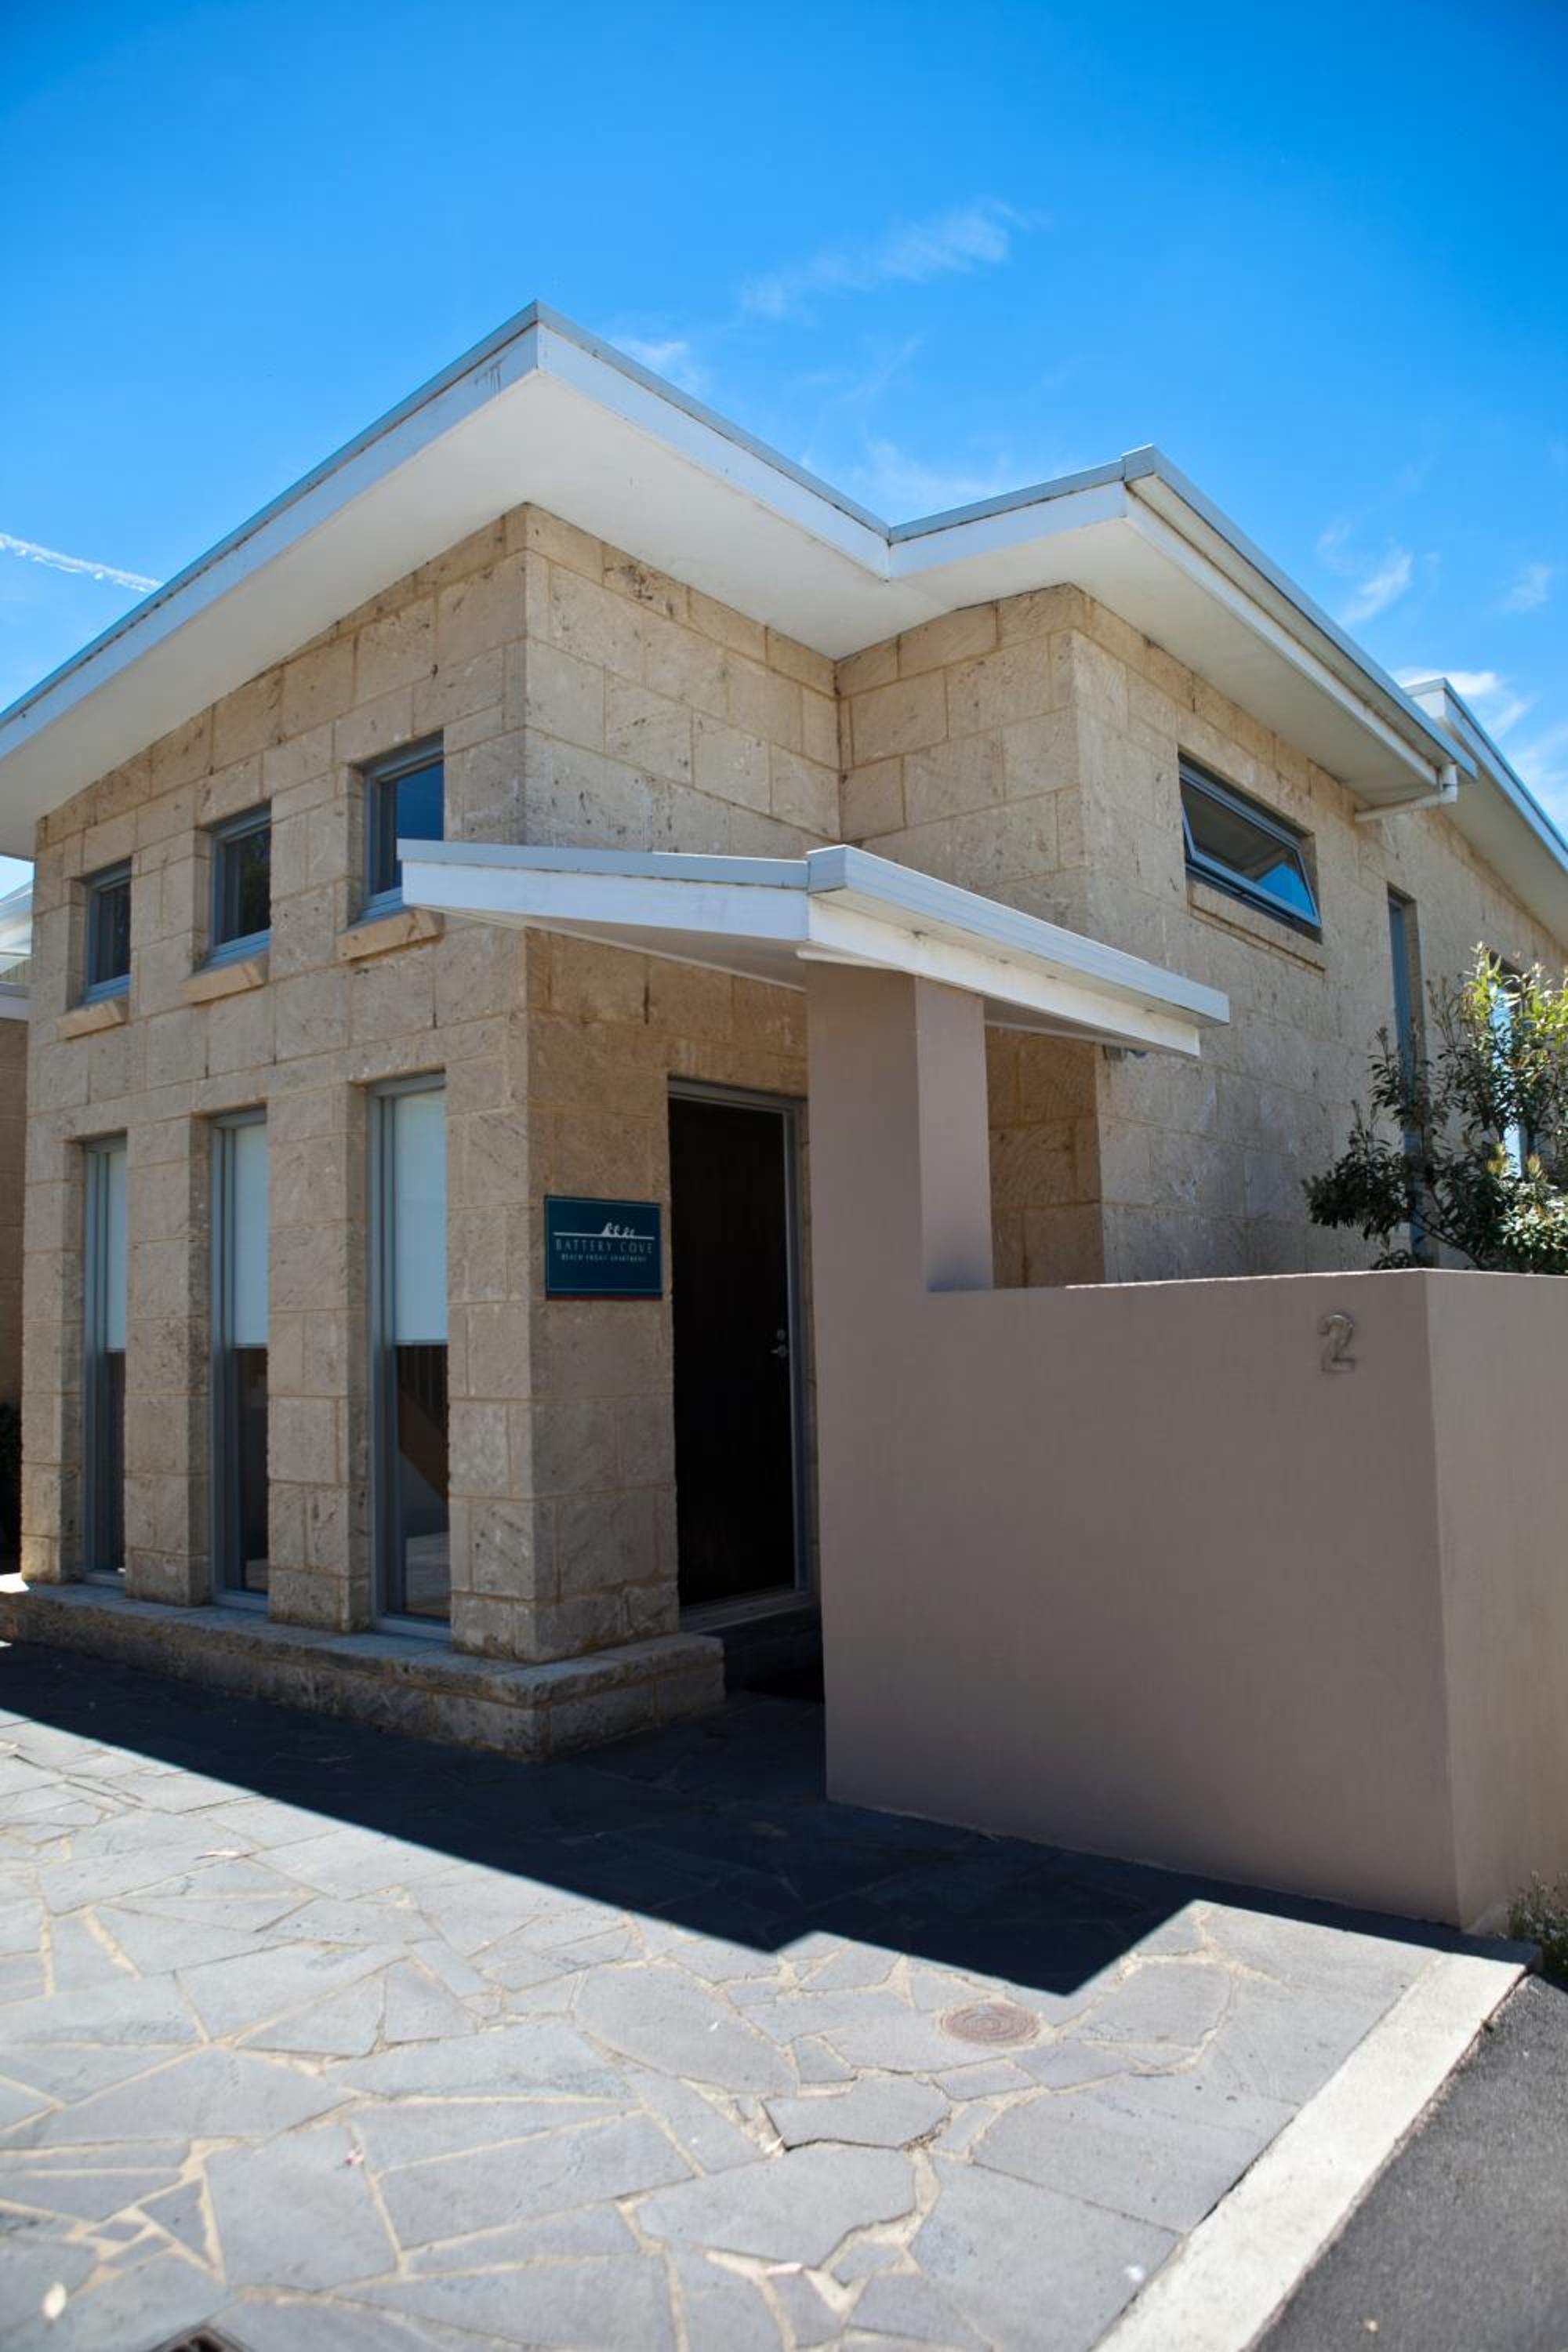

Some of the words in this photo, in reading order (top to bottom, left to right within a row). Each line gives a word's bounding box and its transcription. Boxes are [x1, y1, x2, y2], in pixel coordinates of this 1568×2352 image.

[556, 1239, 612, 1251] BATTERY
[620, 1241, 652, 1254] COVE
[1319, 1312, 1356, 1374] 2
